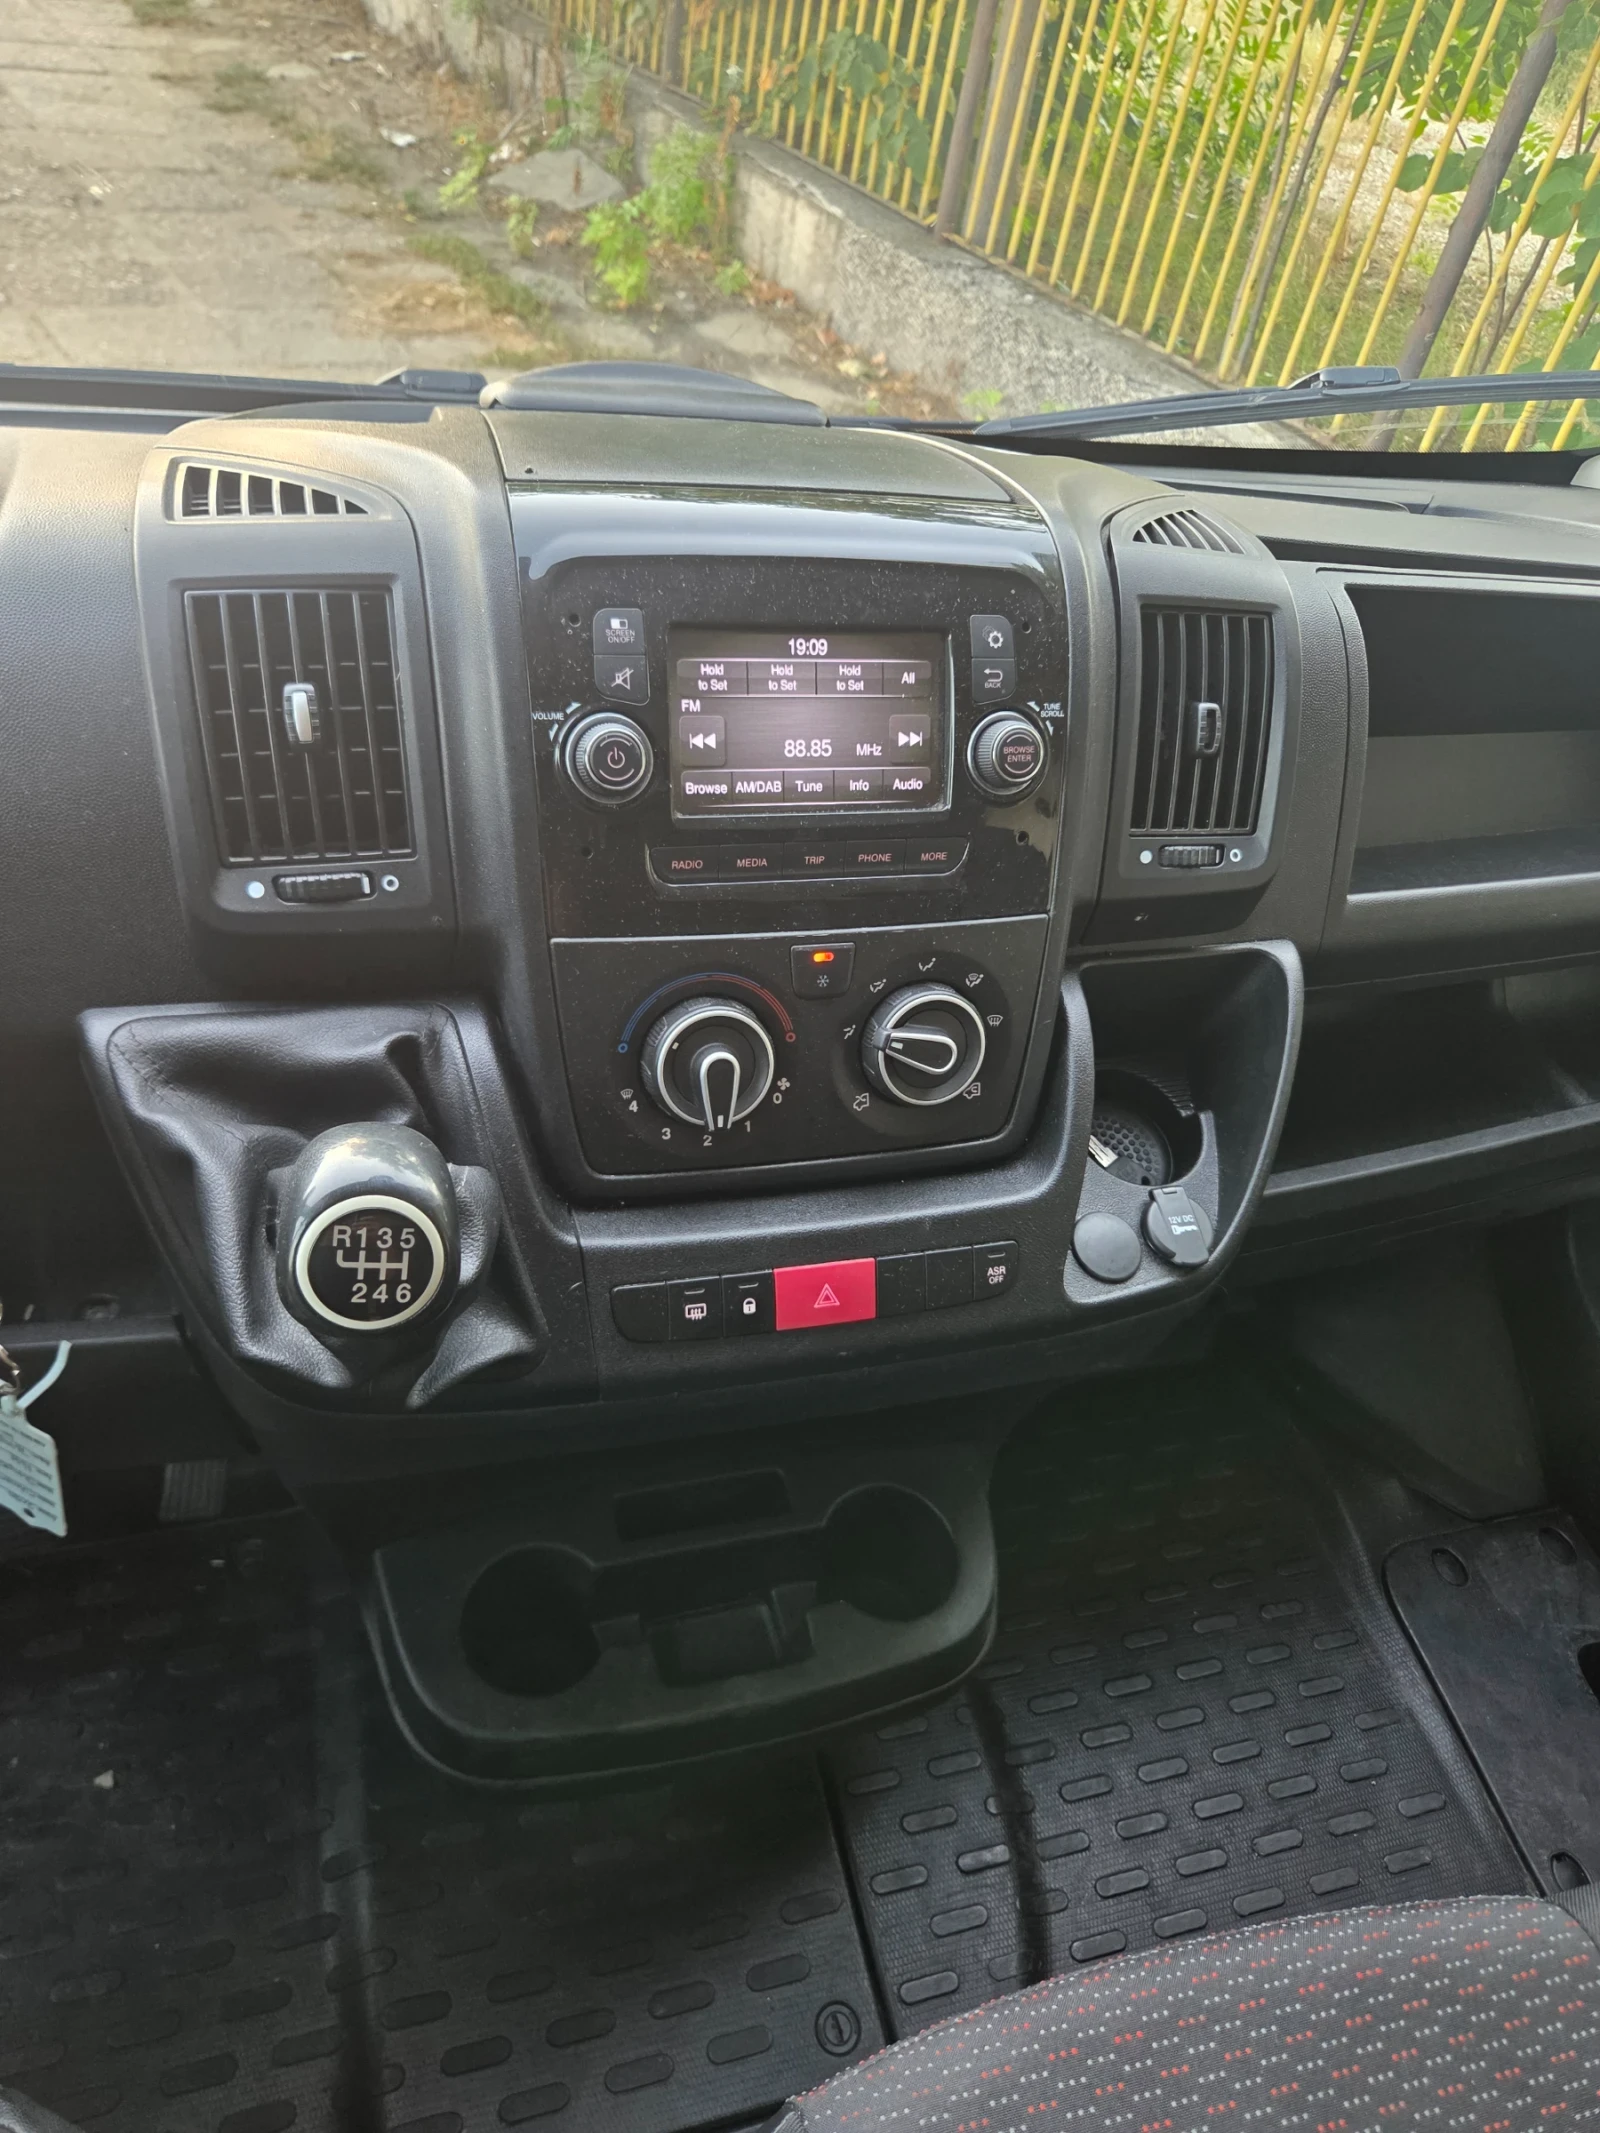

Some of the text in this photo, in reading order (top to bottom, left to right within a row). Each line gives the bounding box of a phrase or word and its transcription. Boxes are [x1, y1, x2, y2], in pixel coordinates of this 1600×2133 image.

[605, 629, 636, 637] SCREEN
[607, 636, 636, 644] ON/OFF
[788, 637, 829, 657] 19:09
[700, 663, 725, 676] Hold
[771, 663, 795, 676] Hold
[839, 664, 862, 676] Hold
[901, 672, 916, 685] All
[698, 679, 729, 692] to Set
[768, 679, 798, 692] to Set
[836, 680, 865, 692] to Set
[681, 699, 702, 713] FM
[1043, 703, 1061, 711] TUNE
[532, 712, 565, 721] VOLUME
[1040, 710, 1064, 718] SCROLL
[784, 738, 883, 758] 88.85 MHz
[1003, 746, 1035, 754] BROWSE
[1007, 754, 1032, 762] ENTER
[685, 782, 729, 794] Browse
[735, 781, 783, 794] AM/DAB
[795, 780, 824, 793] Tune
[849, 778, 870, 792] Info
[892, 778, 924, 791] Audio
[736, 857, 768, 868] MEDIA
[804, 855, 825, 866] TRIP
[857, 853, 893, 864] PHONE
[920, 851, 948, 862] MORE
[671, 859, 704, 870] RADIO
[628, 1100, 639, 1112] 4
[661, 1127, 671, 1139] 3
[744, 1121, 752, 1133] 1
[703, 1135, 713, 1146] 2
[1168, 1214, 1194, 1224] 12V DC
[987, 1265, 1006, 1276] ASR
[988, 1275, 1004, 1285] OFF
